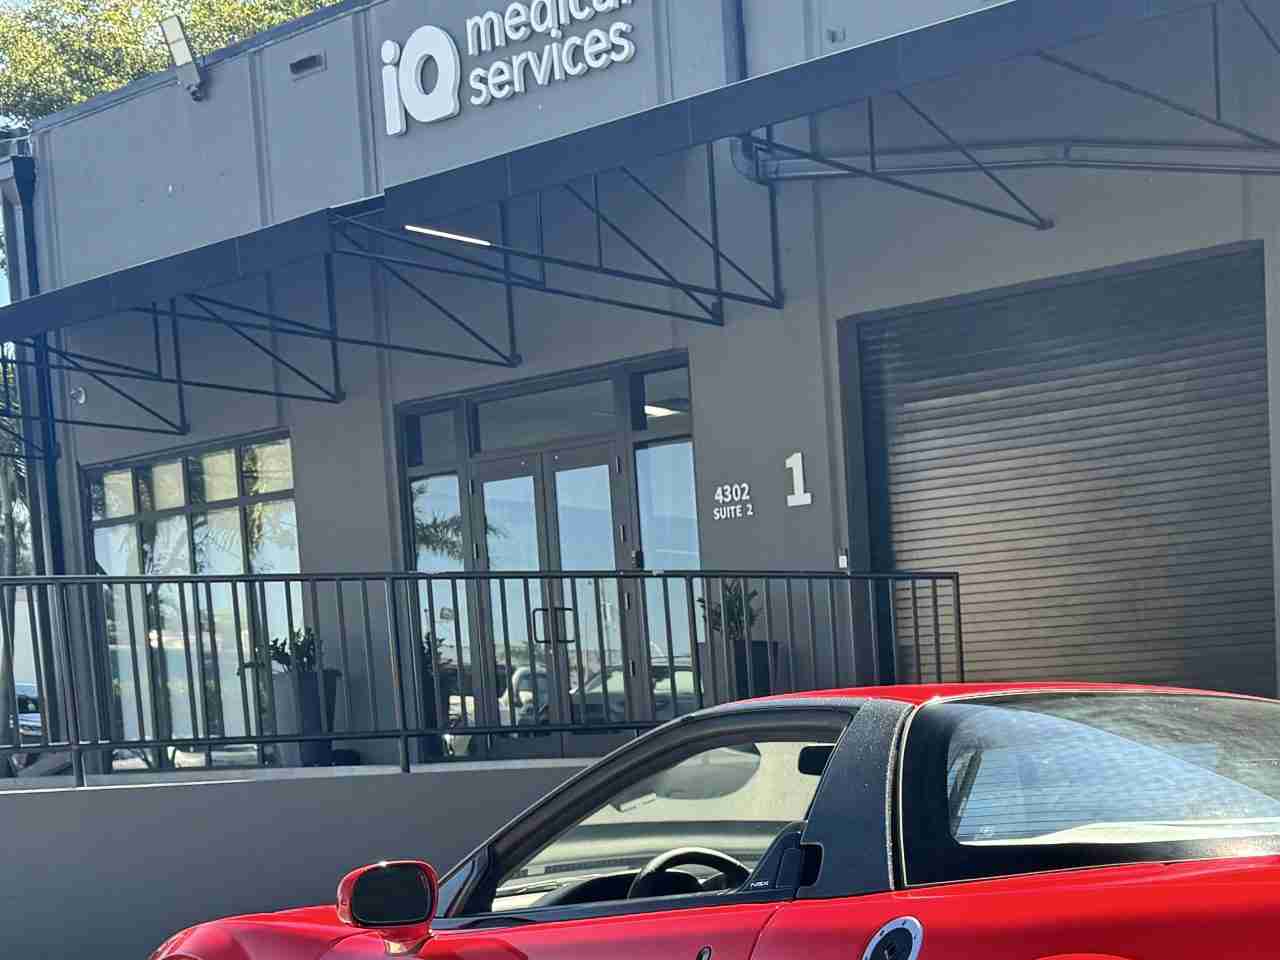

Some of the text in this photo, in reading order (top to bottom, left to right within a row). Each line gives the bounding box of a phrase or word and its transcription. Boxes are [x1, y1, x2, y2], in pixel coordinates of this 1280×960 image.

[469, 22, 636, 106] services
[714, 483, 750, 503] 4302
[785, 452, 812, 506] 1
[713, 503, 753, 520] SUITE 2
